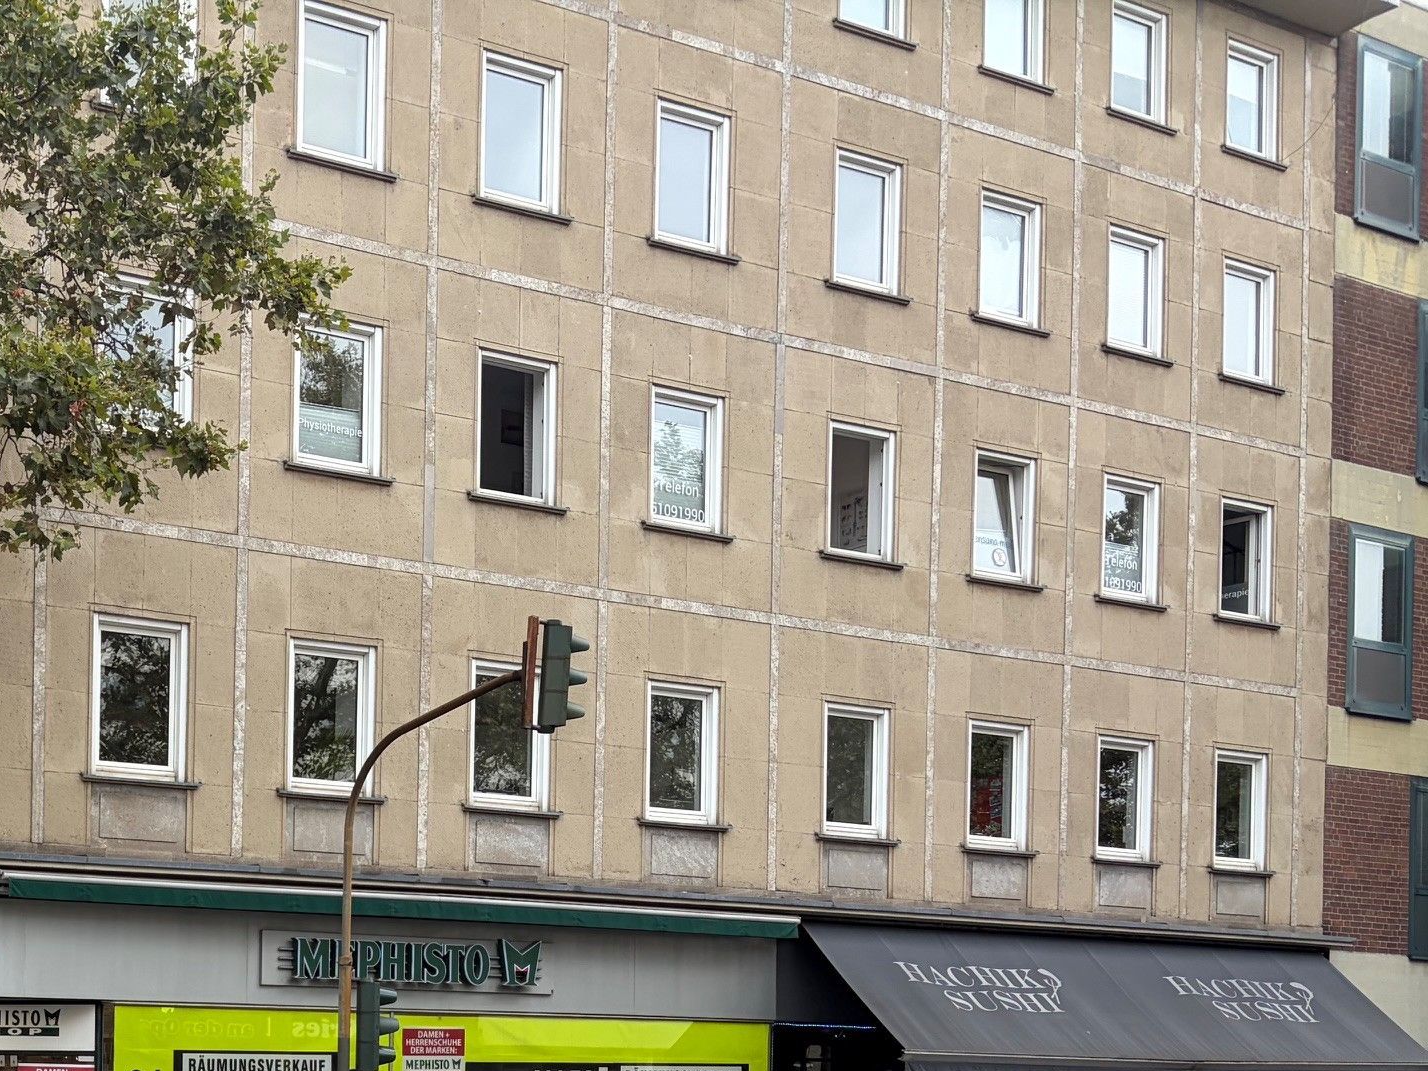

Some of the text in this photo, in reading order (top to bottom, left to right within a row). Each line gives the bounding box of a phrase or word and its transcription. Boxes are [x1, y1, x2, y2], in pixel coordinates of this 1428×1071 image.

[299, 417, 363, 438] Physiotherapie
[656, 480, 699, 498] Telefon
[1222, 587, 1249, 600] erapie
[943, 990, 1065, 1013] SUSHI
[1212, 1000, 1320, 1023] SUSHI
[406, 1059, 450, 1070] MEPHISTO
